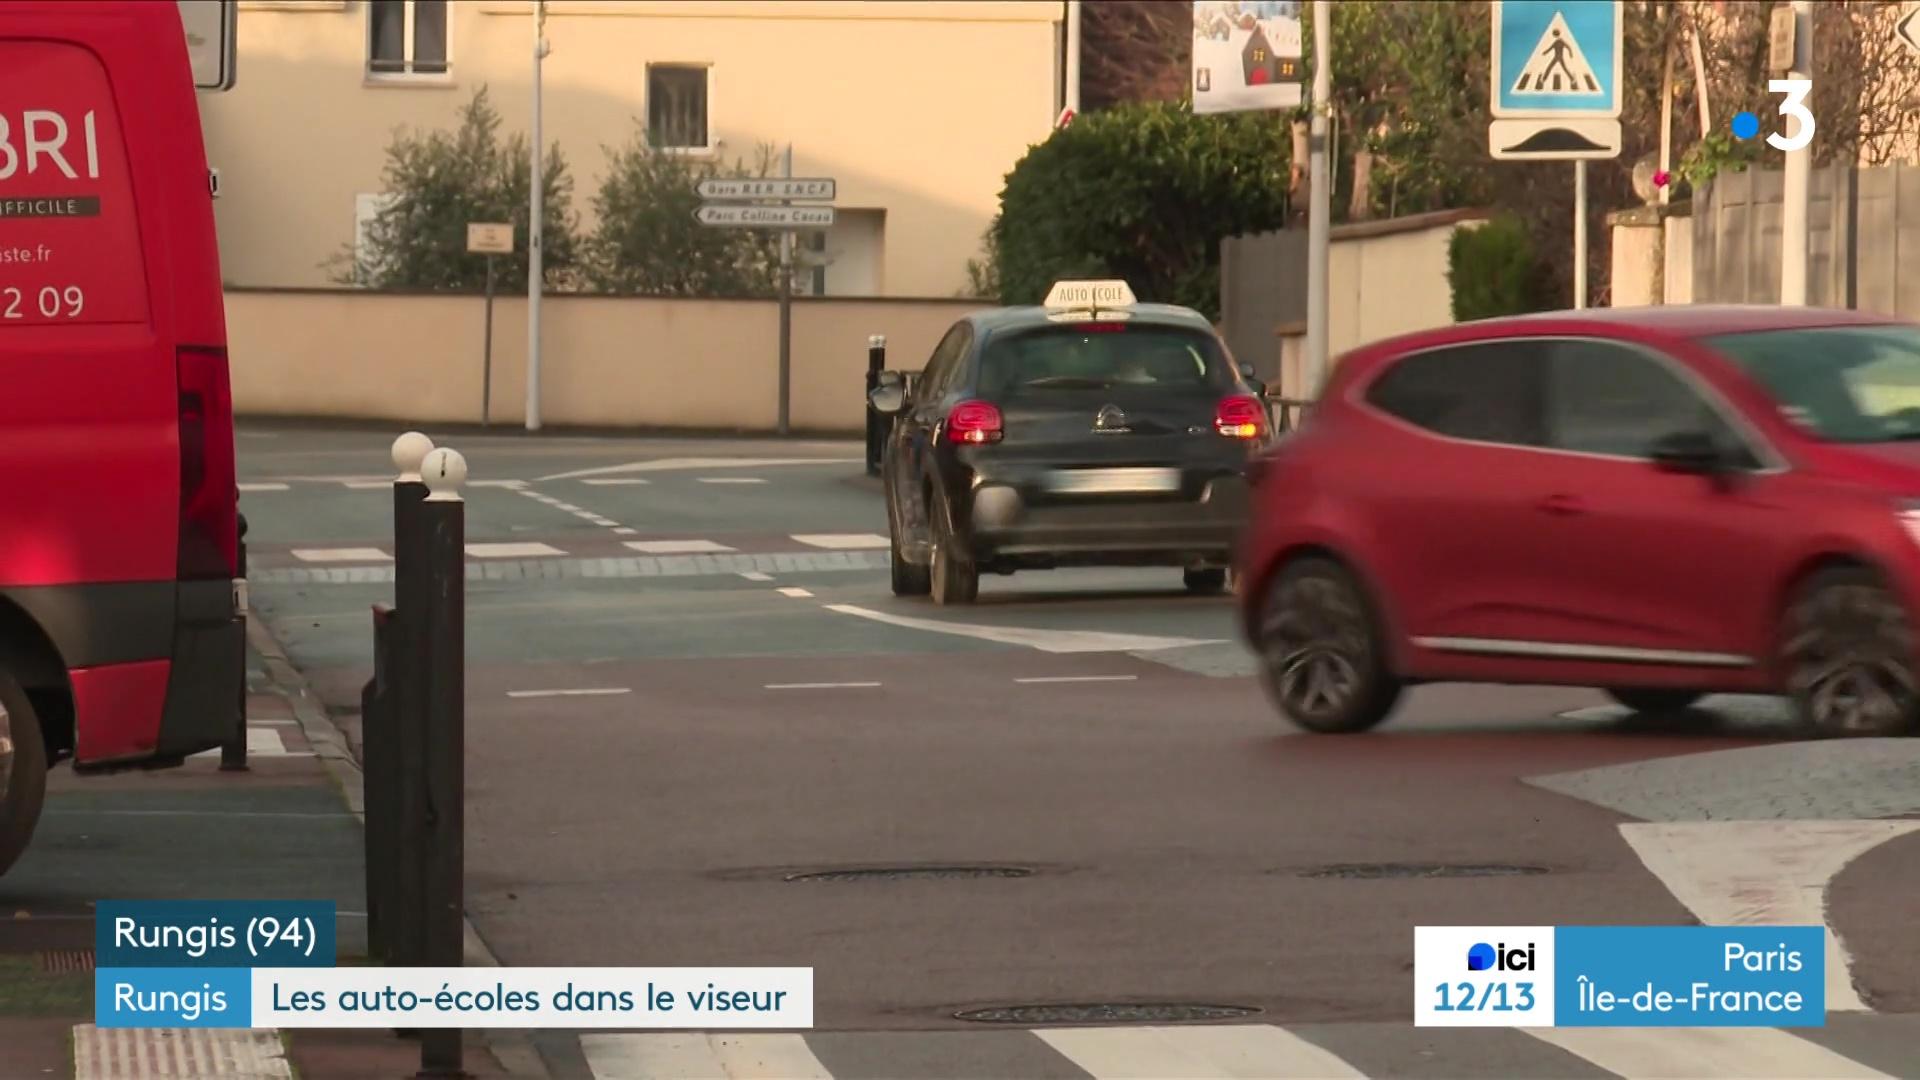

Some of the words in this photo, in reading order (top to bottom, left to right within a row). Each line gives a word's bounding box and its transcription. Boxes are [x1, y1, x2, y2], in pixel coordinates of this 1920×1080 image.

[707, 209, 735, 220] Parc
[1059, 287, 1088, 301] AUTO
[39, 286, 84, 317] 09
